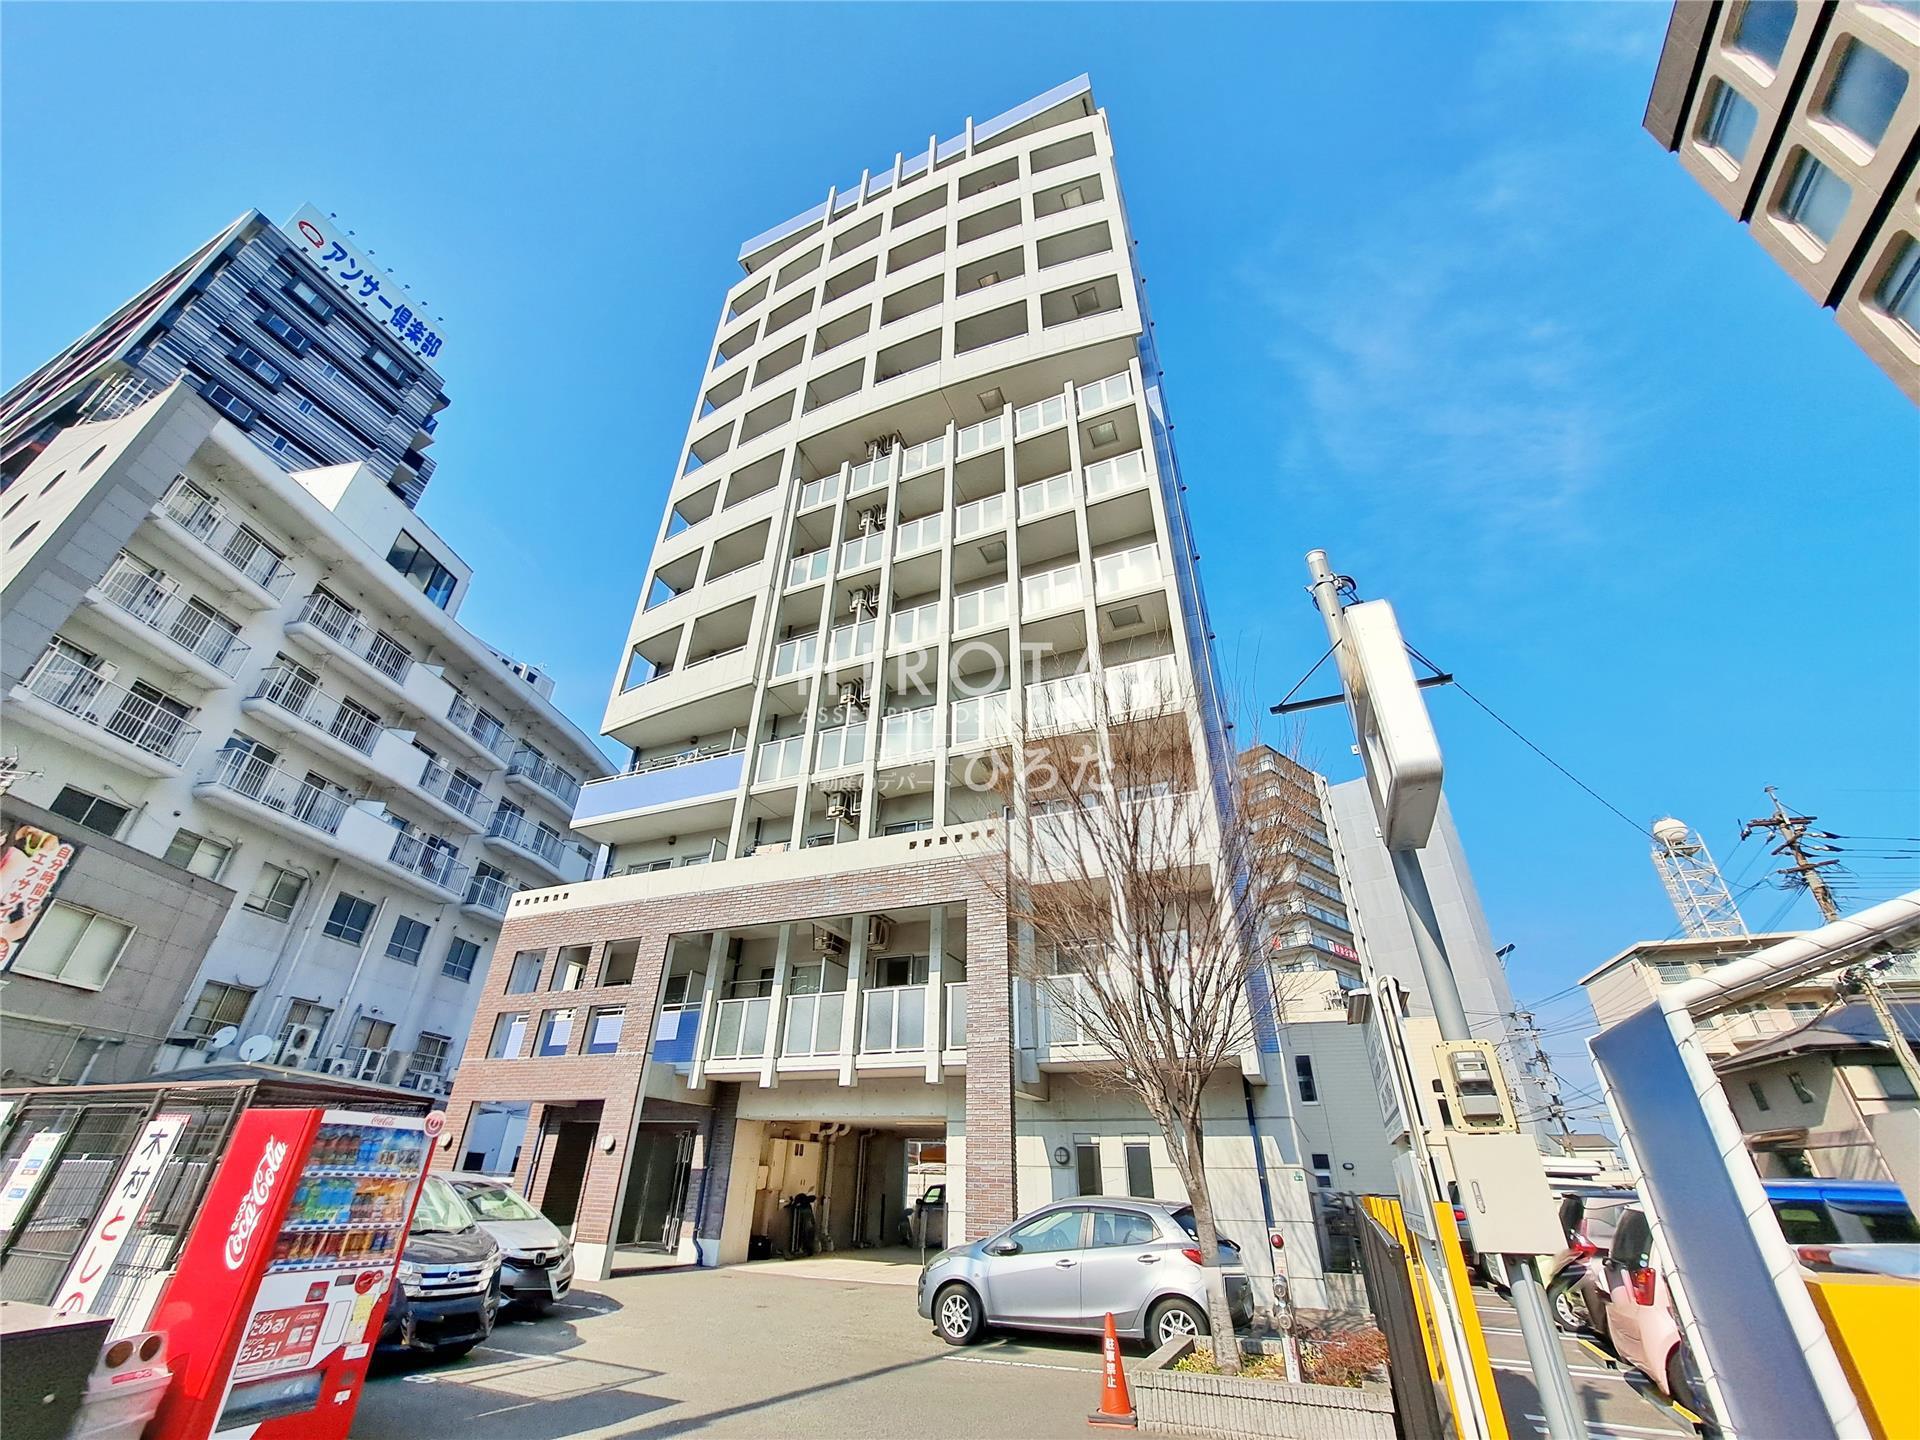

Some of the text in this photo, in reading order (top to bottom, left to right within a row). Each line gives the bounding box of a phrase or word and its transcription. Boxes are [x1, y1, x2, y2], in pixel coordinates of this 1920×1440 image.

[322, 241, 443, 358] アンサー倶楽部
[0, 853, 47, 922] エクササイ
[225, 1134, 289, 1271] Coca-Cola
[1105, 1338, 1117, 1389] 駐車禁止
